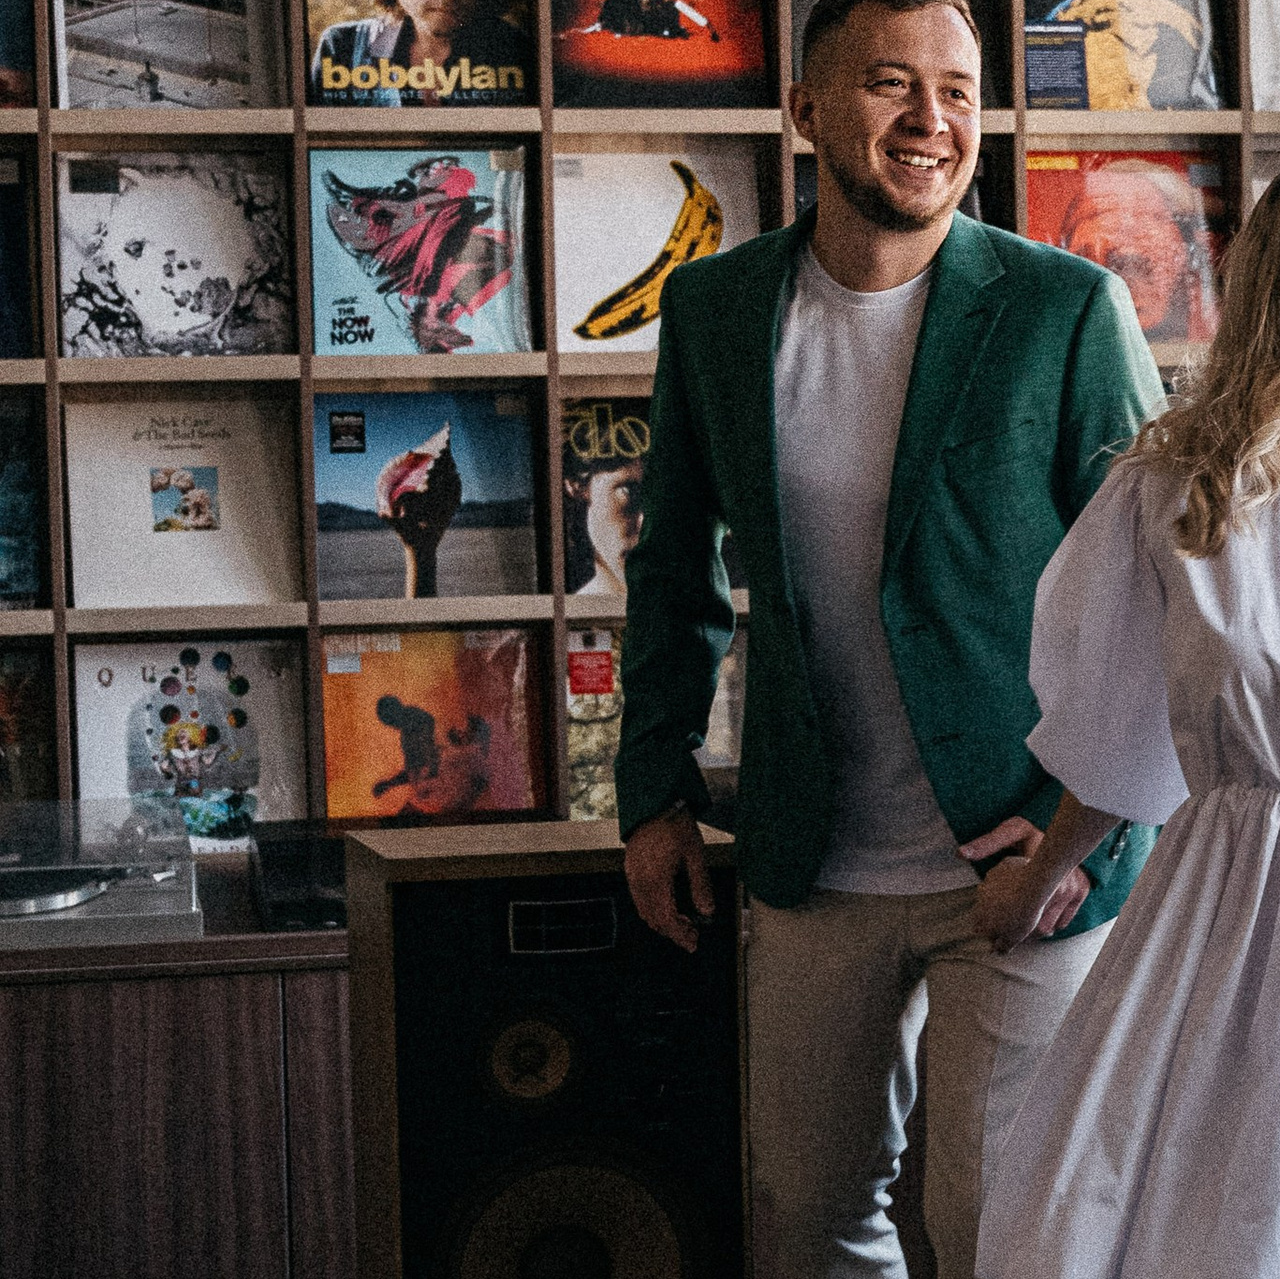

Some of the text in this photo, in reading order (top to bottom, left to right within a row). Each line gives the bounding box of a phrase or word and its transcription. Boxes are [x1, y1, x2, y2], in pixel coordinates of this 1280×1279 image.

[321, 56, 525, 99] bobdylan
[331, 315, 370, 330] NOW
[330, 328, 375, 346] NOW
